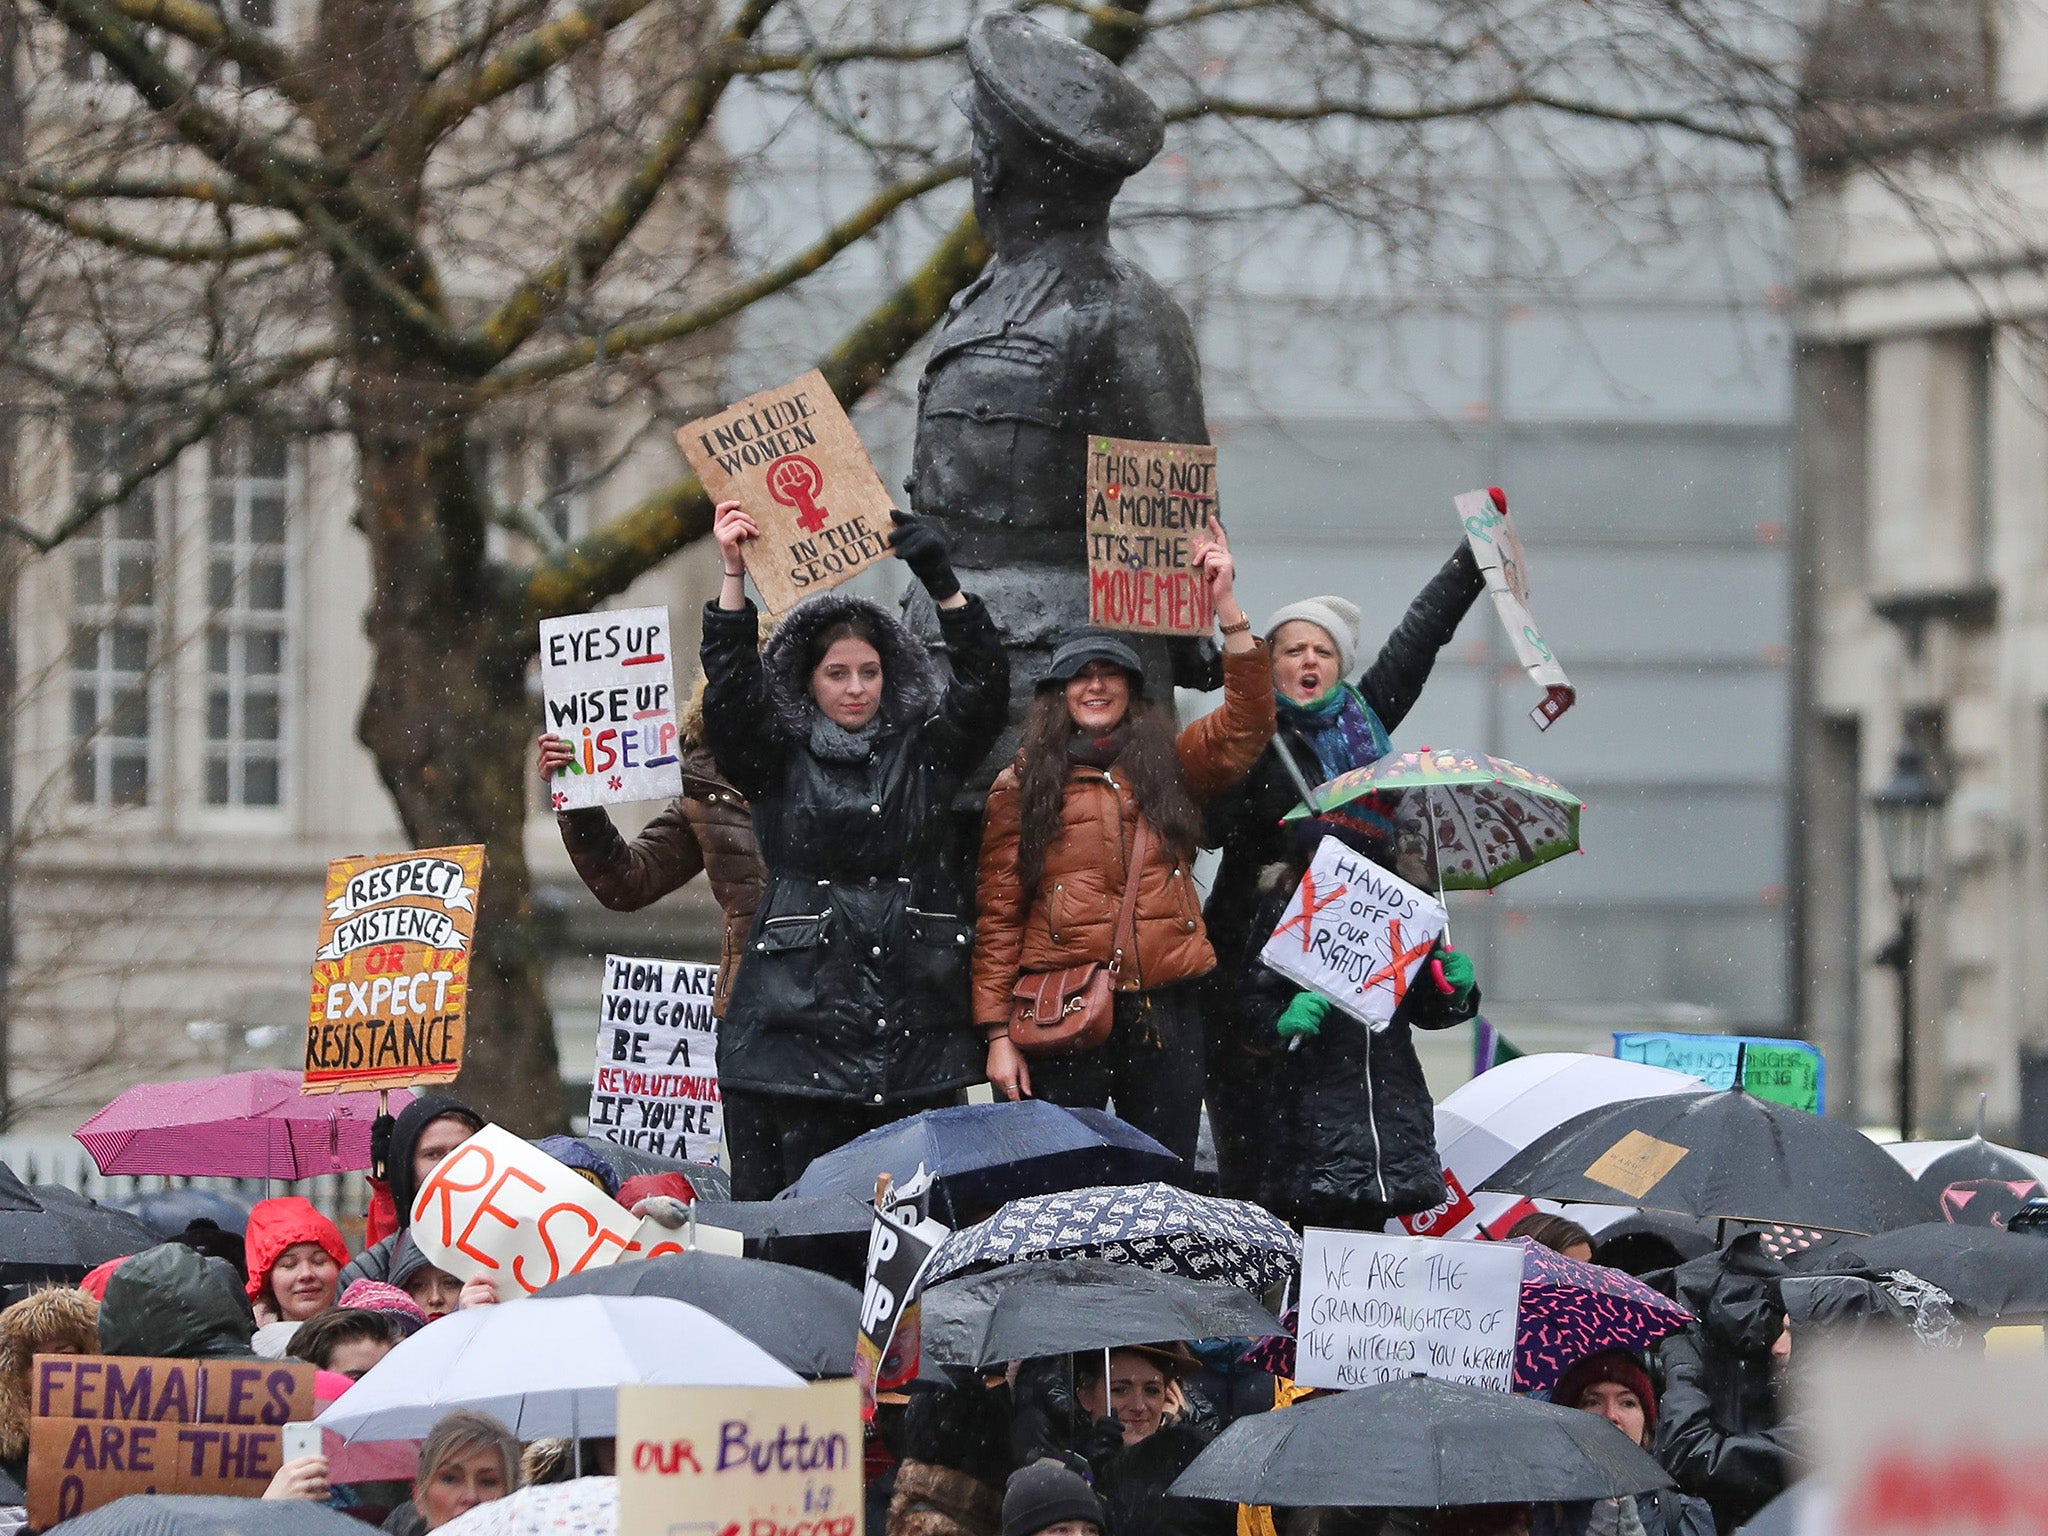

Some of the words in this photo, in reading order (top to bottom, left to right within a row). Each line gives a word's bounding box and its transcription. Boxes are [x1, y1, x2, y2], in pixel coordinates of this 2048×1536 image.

[699, 392, 816, 457] INCLUDE
[716, 421, 817, 477] WOMEN
[1091, 451, 1140, 488] THIS
[1145, 459, 1165, 489] IS
[1169, 463, 1216, 494] NOT
[1090, 491, 1109, 522] A
[1119, 494, 1214, 530] MOMENT
[789, 538, 820, 565] IN
[820, 516, 872, 550] THE
[790, 530, 891, 588] SEQUEL
[1090, 533, 1130, 562] IT'S
[1135, 536, 1188, 568] THE
[351, 860, 460, 907] RESPECT
[1334, 857, 1419, 919] HANDS
[337, 908, 449, 952] EXISTENCE
[1350, 901, 1389, 923] OFF
[1338, 922, 1369, 946] OUR
[365, 945, 405, 974] OR
[1310, 928, 1376, 993] RIGHTS!
[326, 971, 453, 1020] EXPECT
[671, 966, 717, 997] ARE
[606, 994, 649, 1025] YOU
[653, 1000, 714, 1032] GONN
[305, 1014, 460, 1070] RESISTANCE
[612, 1028, 650, 1064] BE
[666, 1038, 690, 1067] A
[598, 1067, 721, 1102] REVOLUTIONAR
[592, 1096, 633, 1127] IF
[638, 1099, 714, 1135] YOU'RE
[606, 1128, 665, 1156] SUCH
[670, 1135, 688, 1160] A
[1323, 1246, 1355, 1291] WE
[1367, 1251, 1409, 1290] ARE
[1425, 1253, 1468, 1291] THE
[1311, 1294, 1472, 1332] GRANDDAUGHTERS
[1479, 1308, 1504, 1334] OF
[1302, 1328, 1334, 1361] THE
[1347, 1334, 1415, 1362] WITCHES
[1427, 1340, 1456, 1367] YOU
[39, 1361, 296, 1426] FEMALES
[1336, 1364, 1369, 1385] ABLE
[1372, 1366, 1390, 1385] TO
[63, 1425, 157, 1472] ARE
[178, 1430, 276, 1480] THE
[716, 1420, 848, 1473] Button
